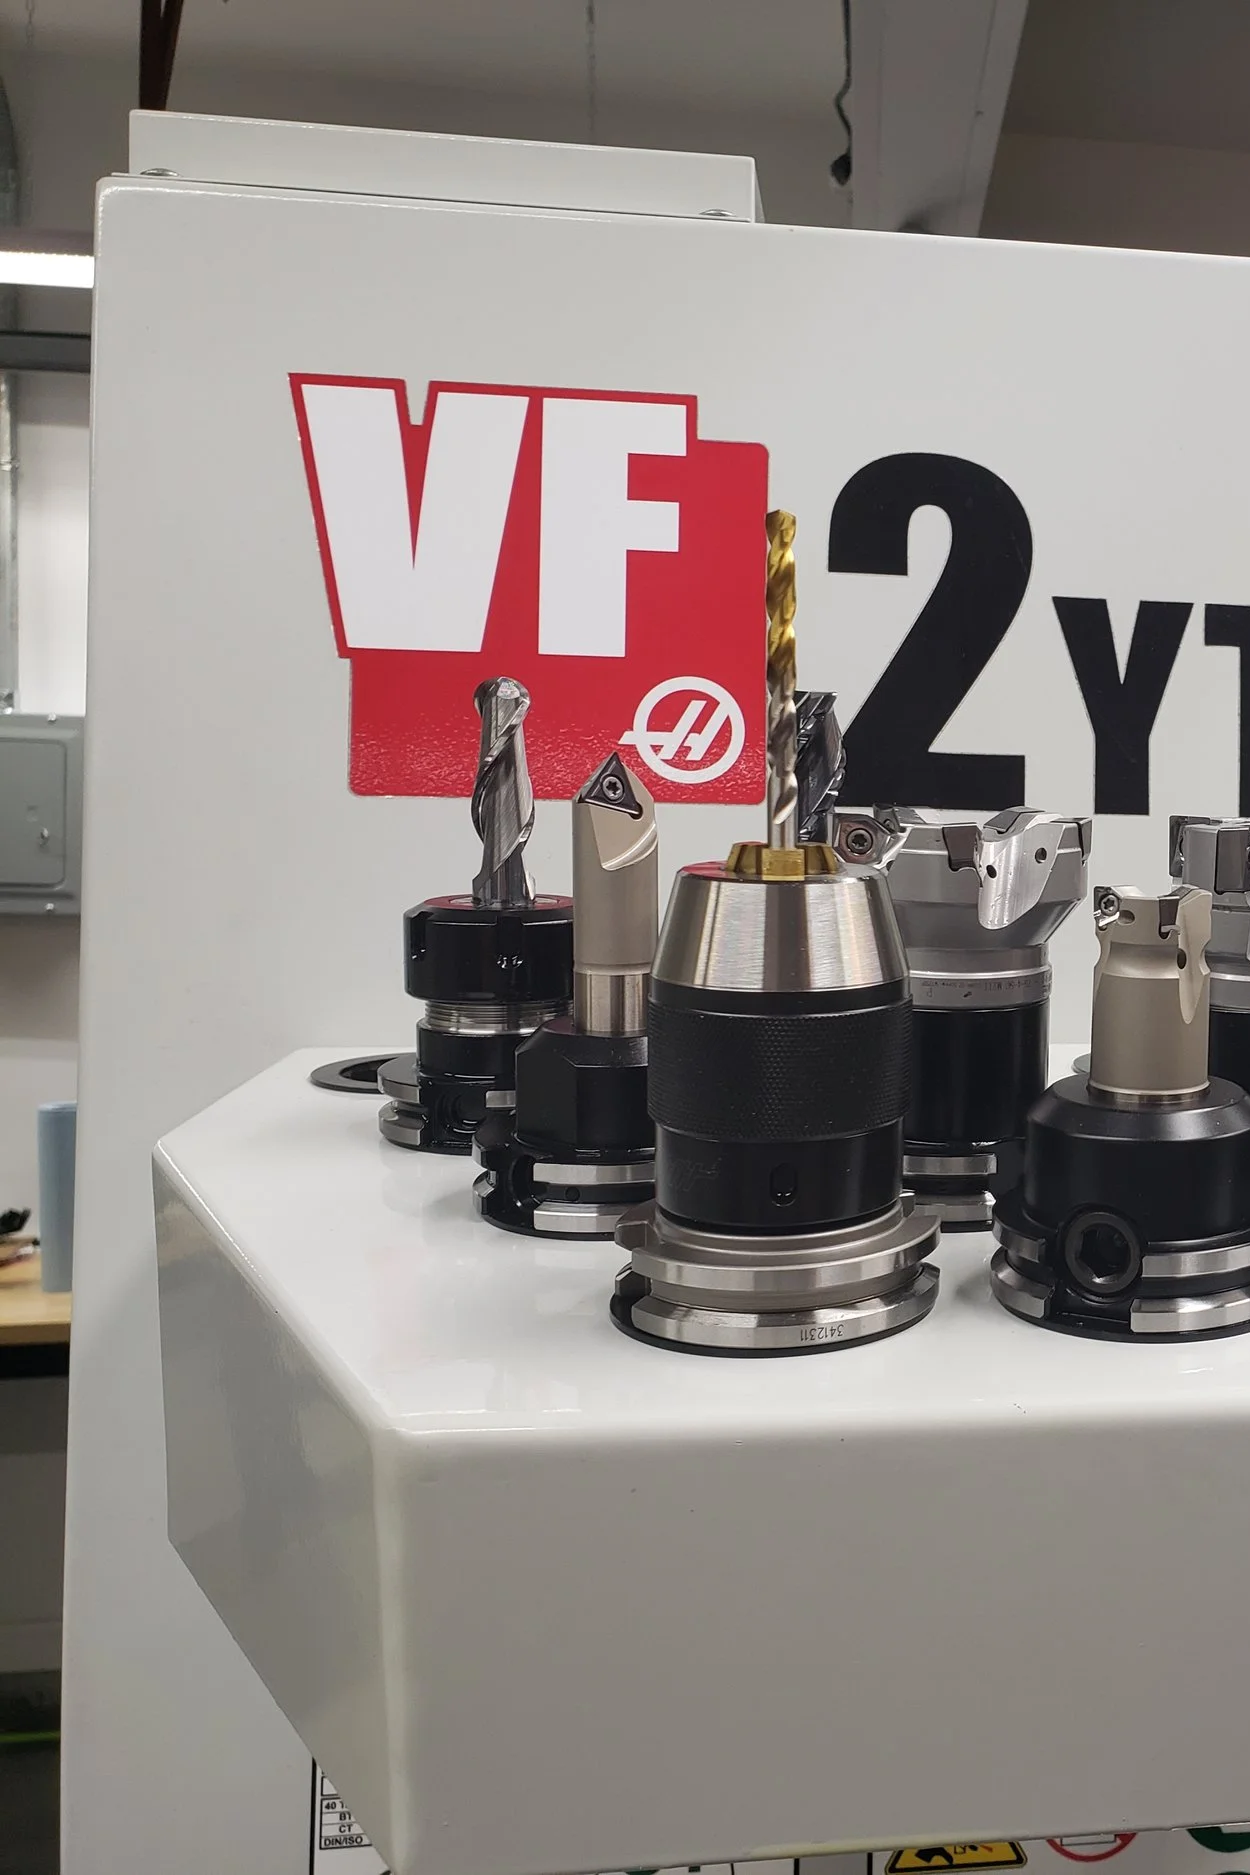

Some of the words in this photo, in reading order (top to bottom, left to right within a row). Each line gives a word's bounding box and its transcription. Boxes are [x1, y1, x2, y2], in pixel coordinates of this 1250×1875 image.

[301, 383, 687, 658] VF
[800, 1324, 844, 1341] 3412311
[325, 1801, 336, 1809] 40
[338, 1824, 353, 1834] CT
[324, 1836, 363, 1846] DIN/ISO
